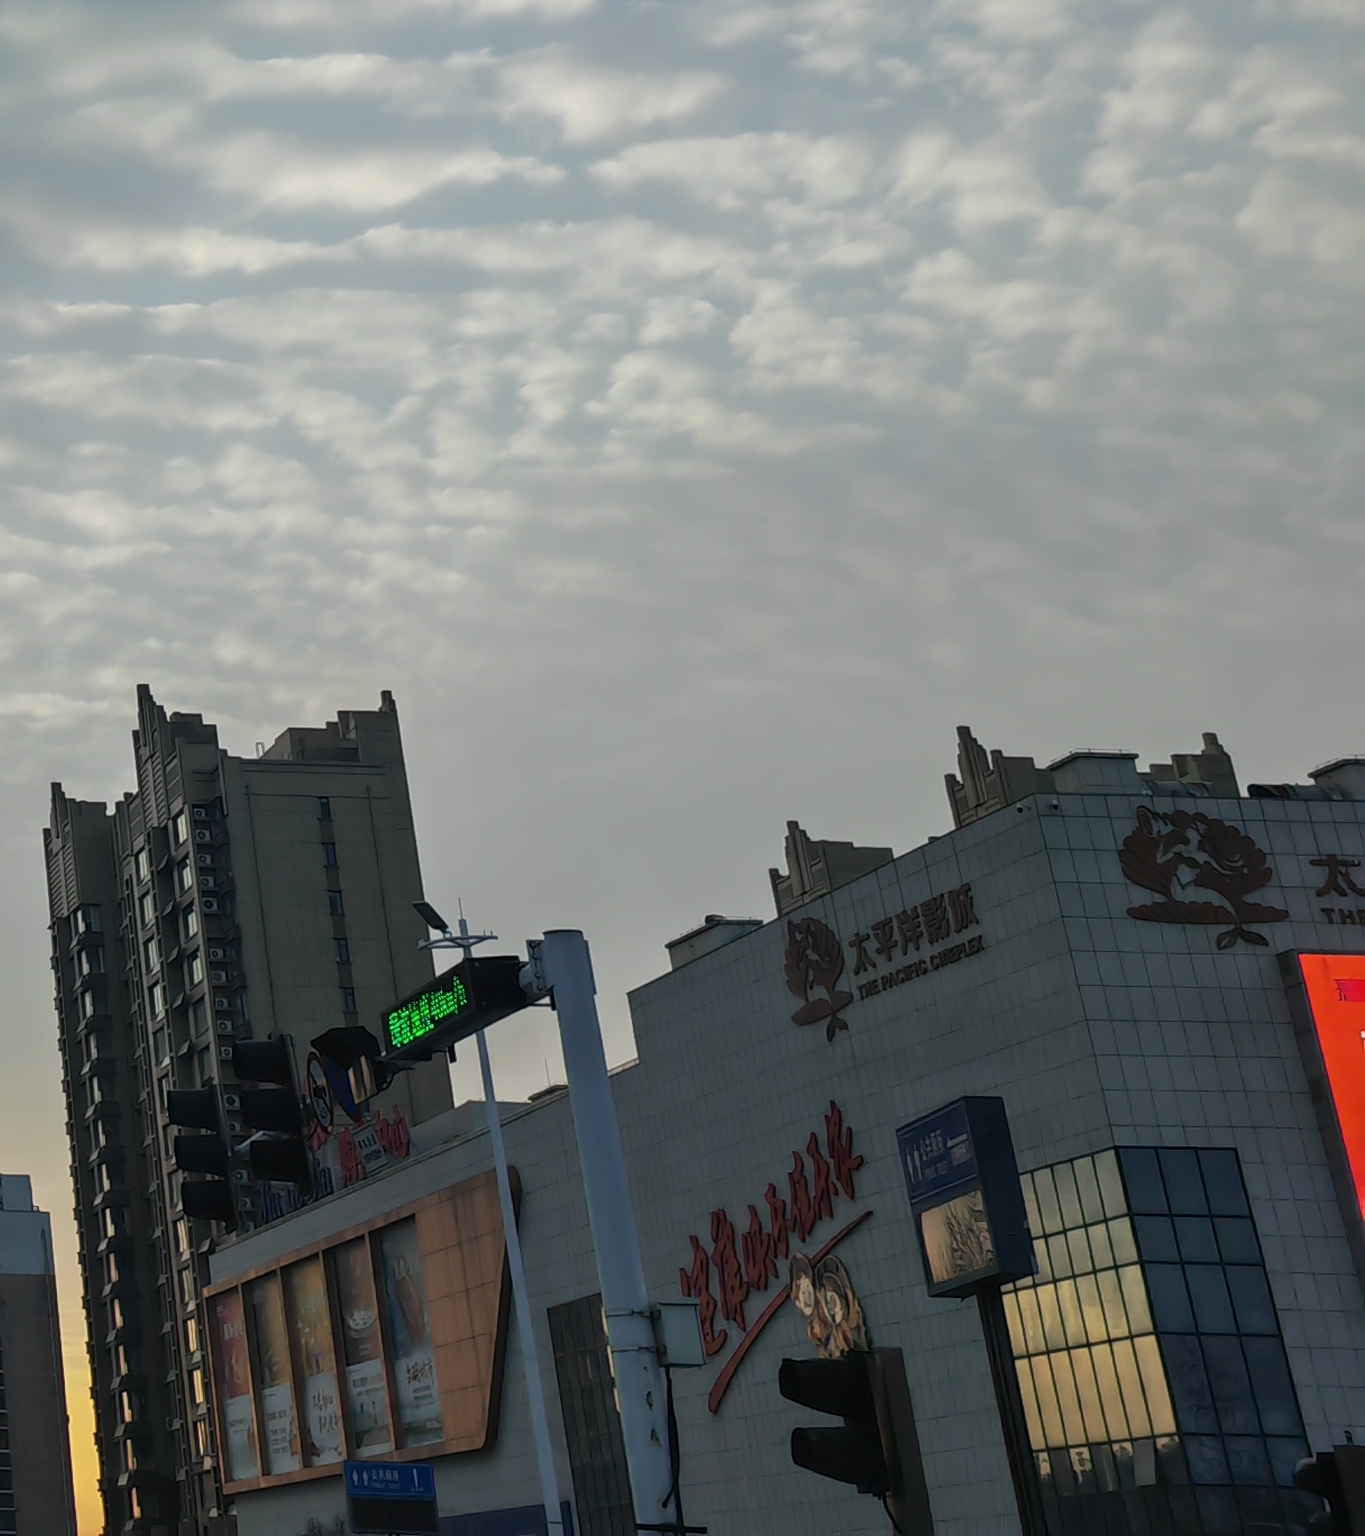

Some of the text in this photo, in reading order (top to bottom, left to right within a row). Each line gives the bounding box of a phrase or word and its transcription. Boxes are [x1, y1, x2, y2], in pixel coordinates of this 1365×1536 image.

[848, 882, 980, 976] 太平洋影城
[857, 981, 880, 1000] THE
[880, 958, 929, 991] PACIFIC
